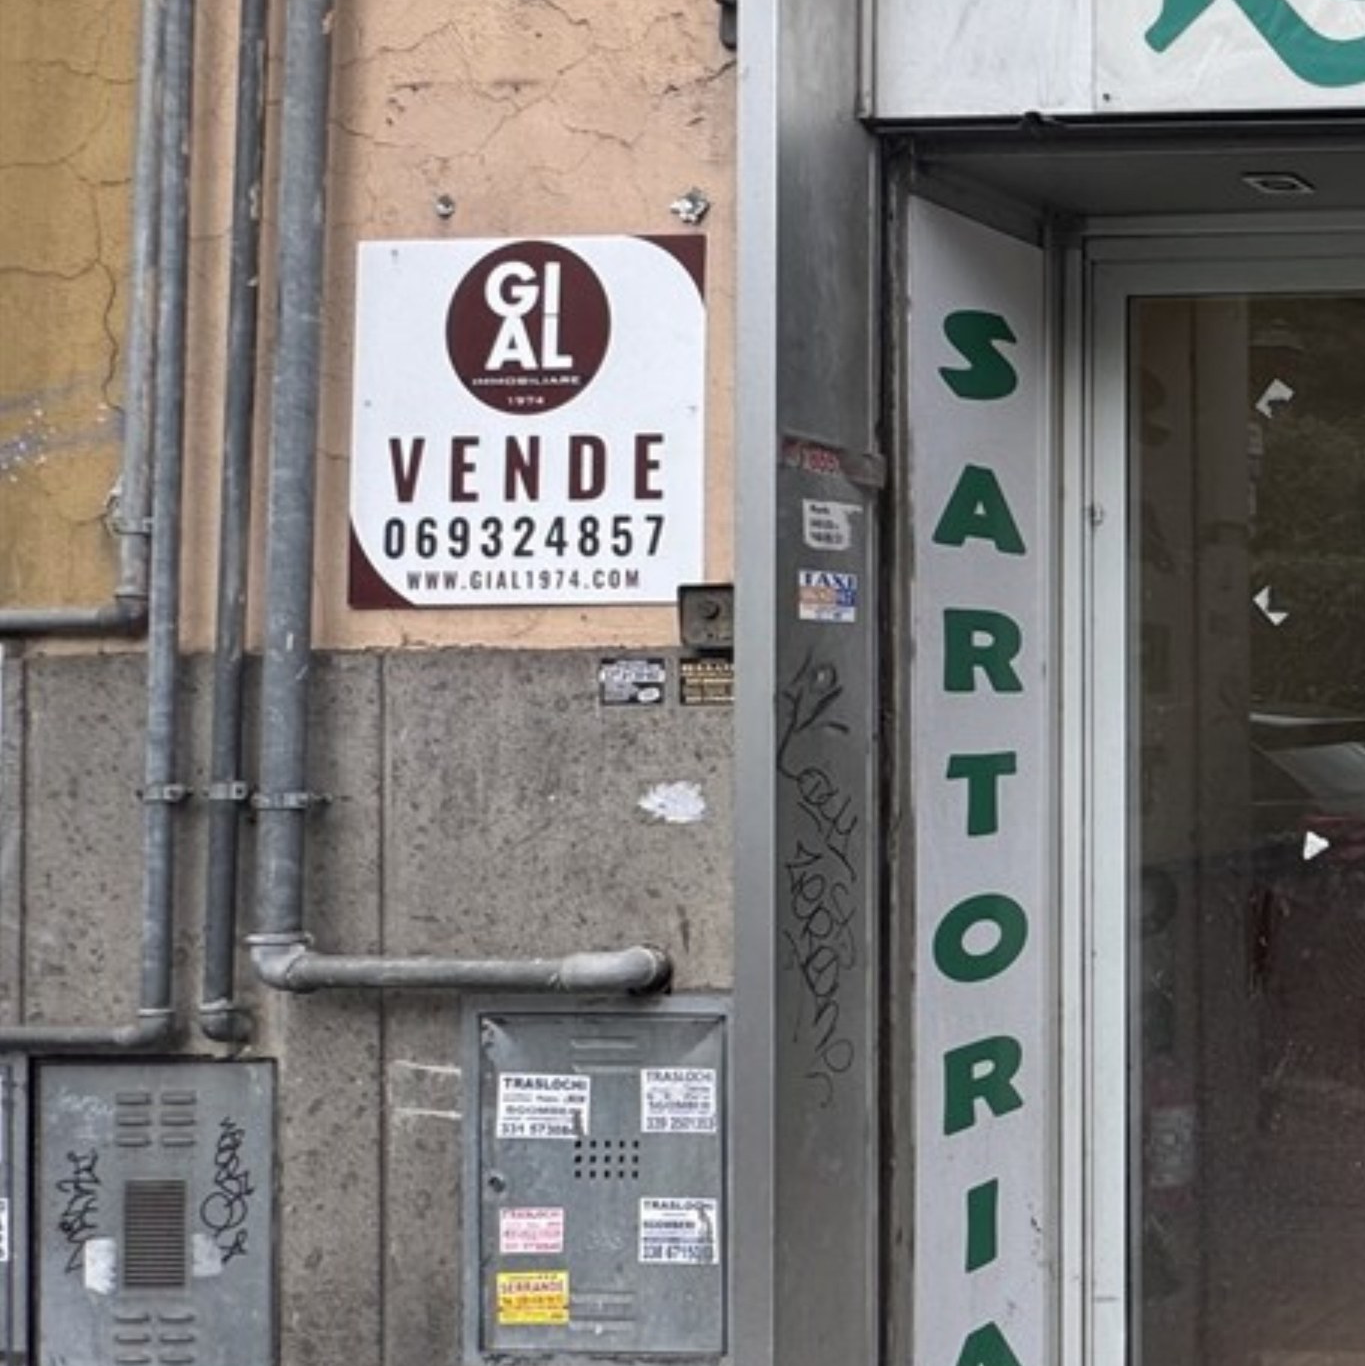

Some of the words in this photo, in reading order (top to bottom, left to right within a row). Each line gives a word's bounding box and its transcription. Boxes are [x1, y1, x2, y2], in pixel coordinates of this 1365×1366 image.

[507, 395, 545, 406] 1974
[389, 433, 664, 503] VENDE
[383, 514, 664, 560] 069324857
[406, 569, 640, 591] WWW.GIAL1974.COM
[502, 1076, 588, 1091] TRASLOCHI
[646, 1071, 714, 1082] TRASLOCHI
[643, 1200, 715, 1211] TRASLOCHI
